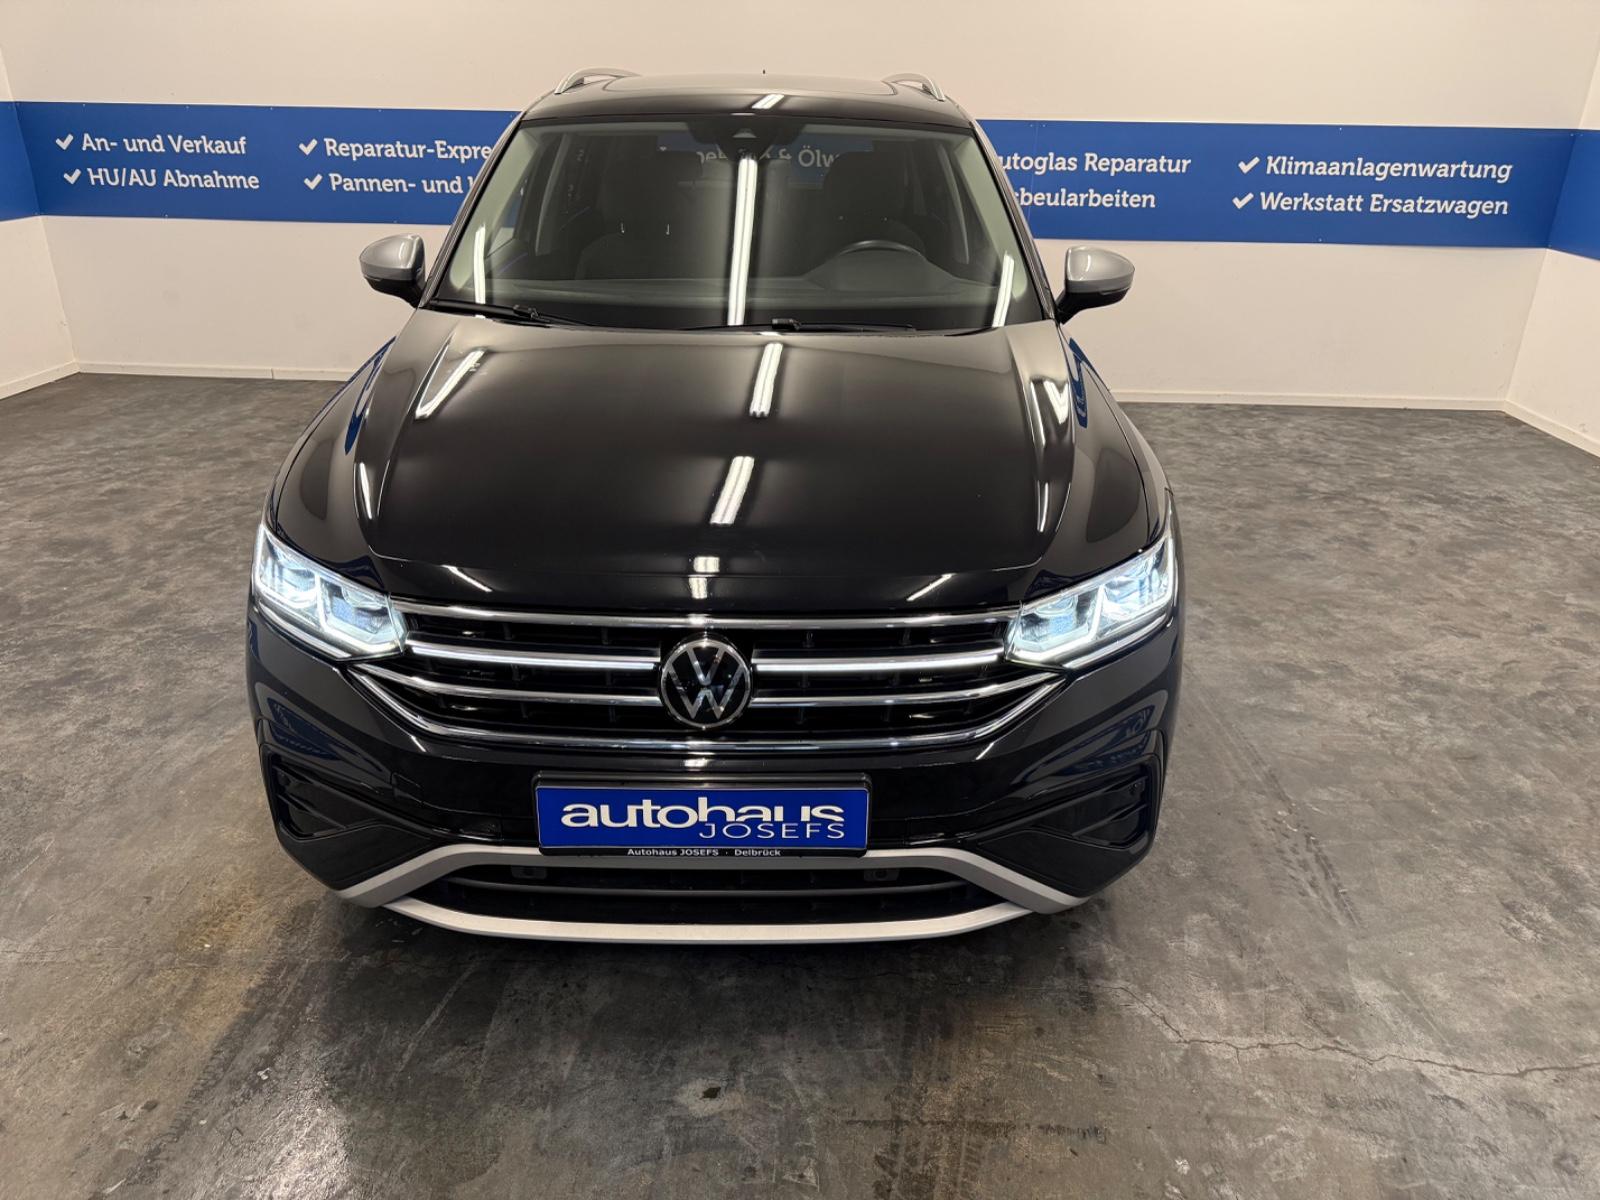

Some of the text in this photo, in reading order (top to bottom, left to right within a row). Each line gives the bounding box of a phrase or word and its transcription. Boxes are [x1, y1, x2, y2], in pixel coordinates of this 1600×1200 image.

[82, 132, 247, 154] An- und Verkauf
[1084, 153, 1192, 176] Reparatur
[1266, 156, 1513, 183] Klimaanlagenwartung
[87, 167, 260, 189] HU/AU Abnahme
[328, 172, 416, 192] Pannen-
[422, 175, 463, 194] und
[1260, 192, 1509, 219] Werkstatt Ersatzwagen
[560, 797, 845, 828] autohaus
[698, 822, 846, 840] JOSEFS
[627, 848, 781, 857] Autohaus JOSEFS Delbrück
